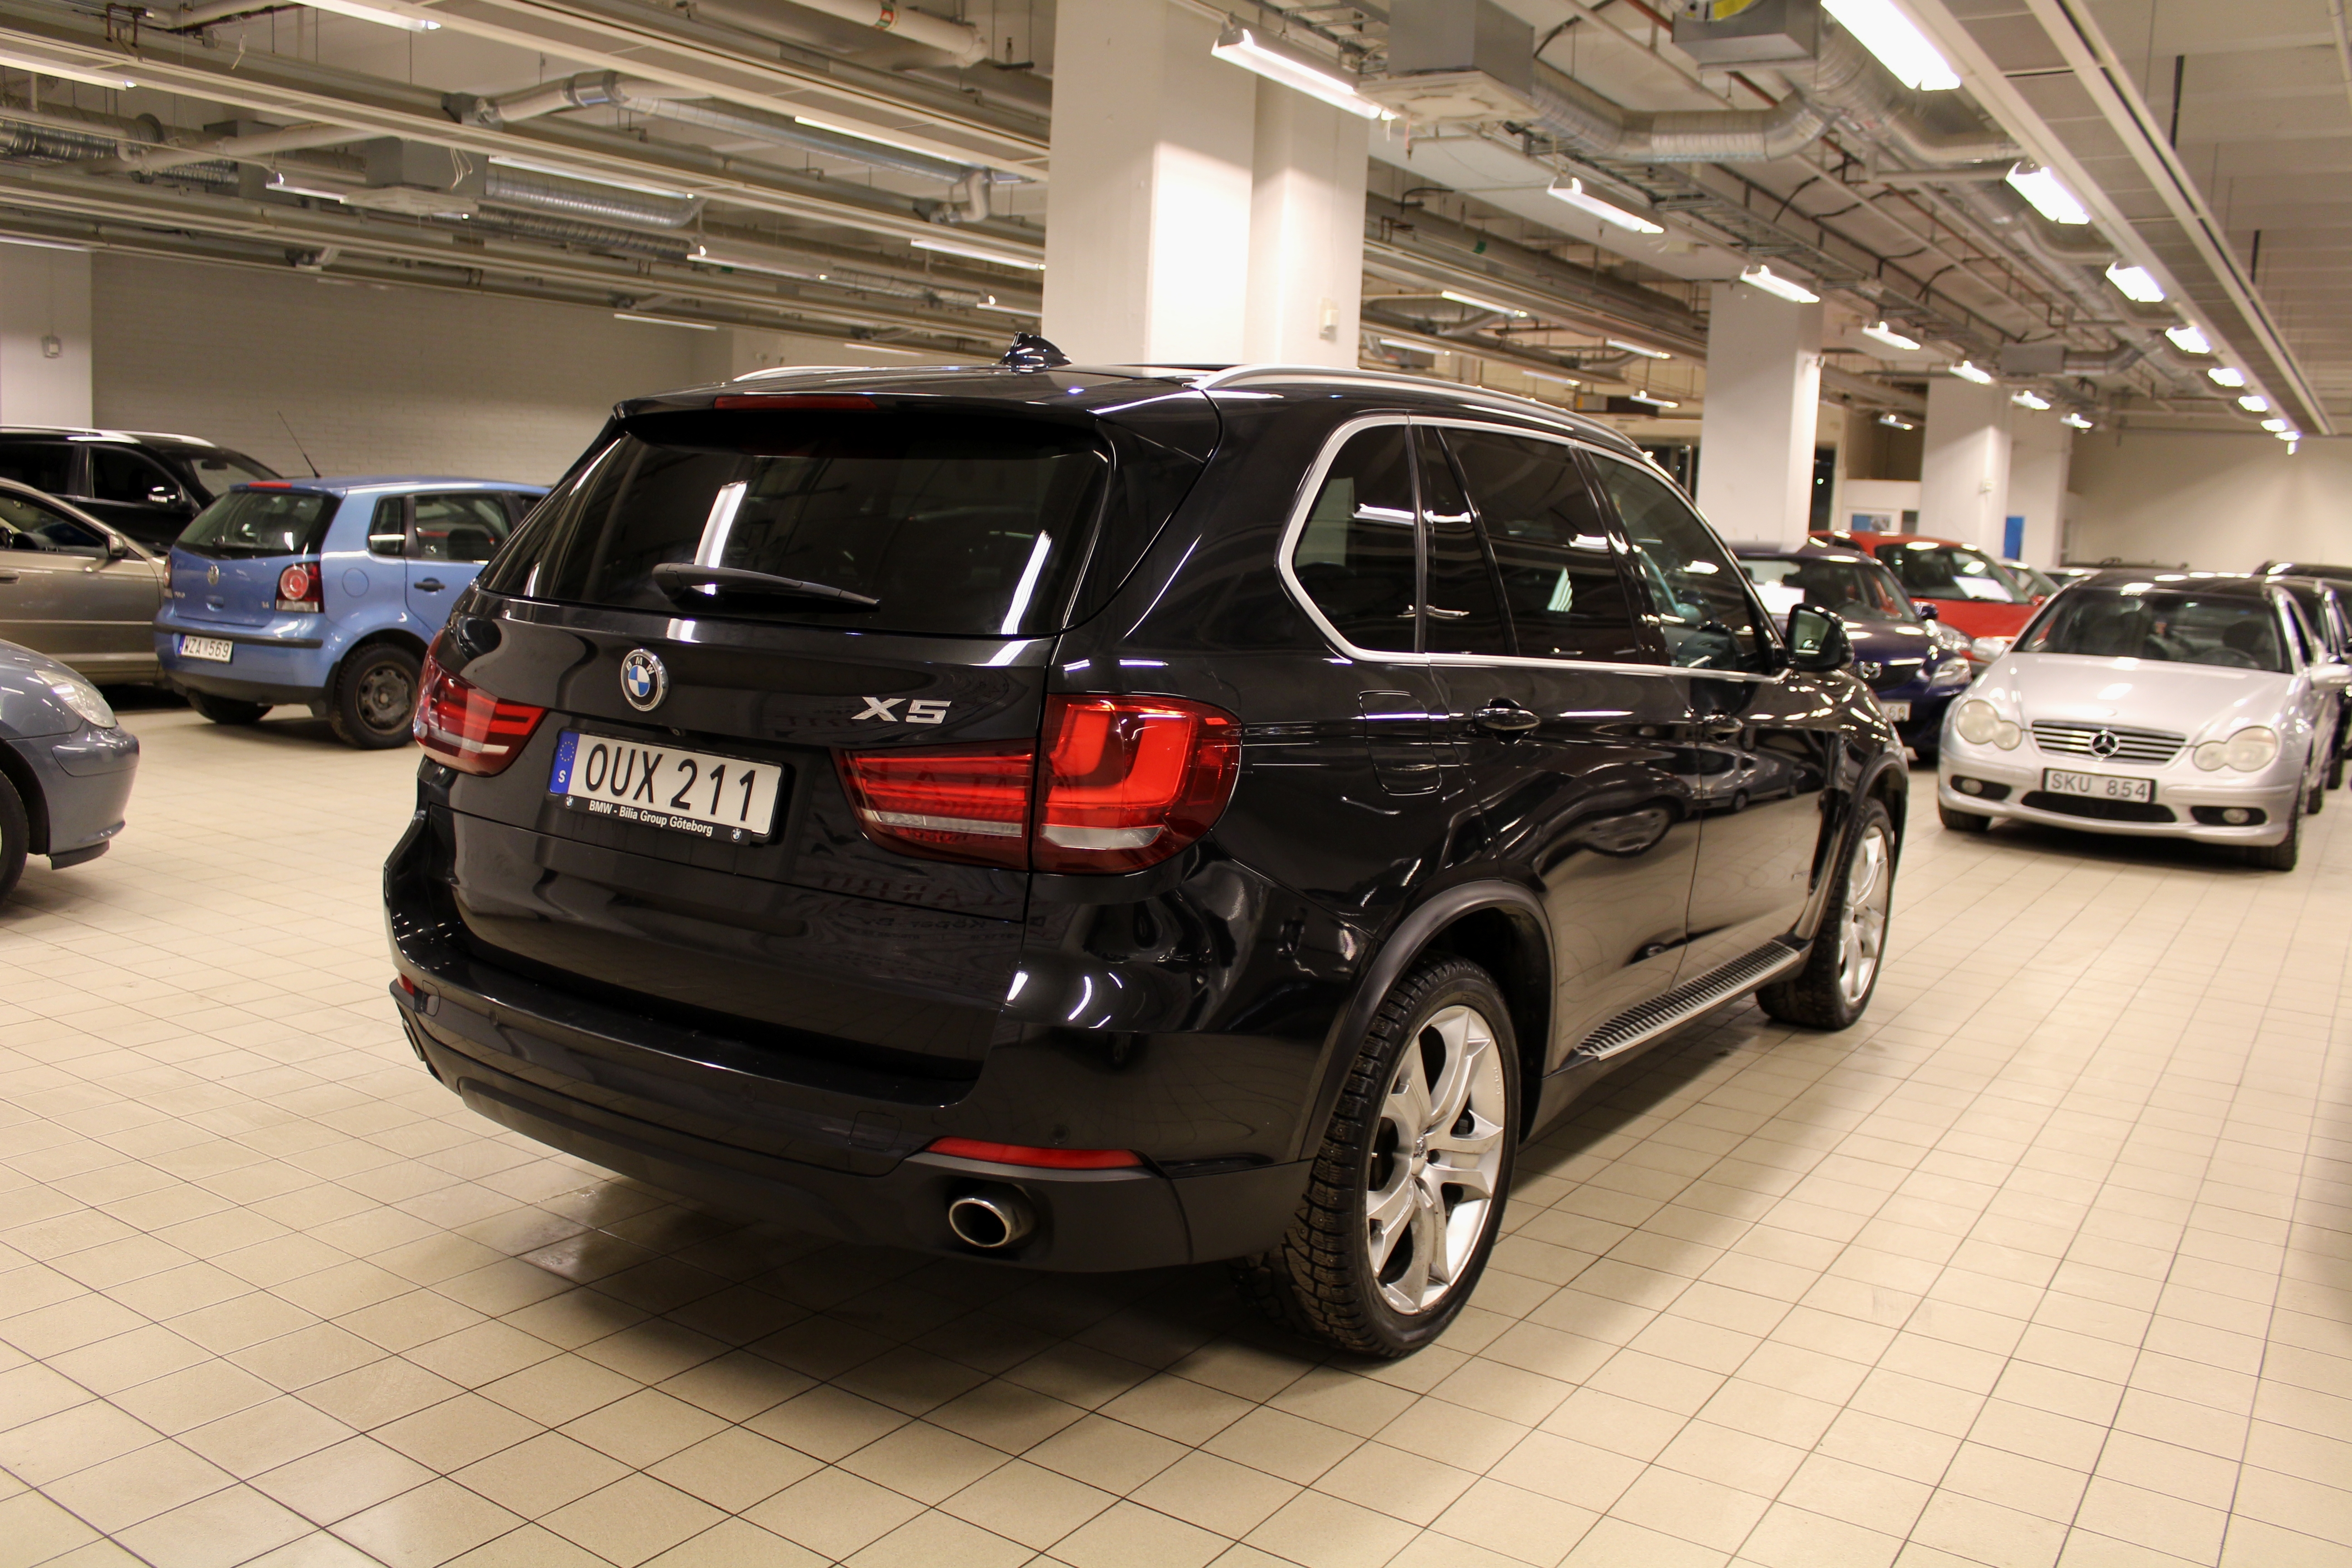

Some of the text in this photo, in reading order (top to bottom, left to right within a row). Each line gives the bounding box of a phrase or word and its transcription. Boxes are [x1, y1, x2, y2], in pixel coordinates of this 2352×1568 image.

[183, 637, 229, 657] WZA 569
[626, 656, 655, 675] BMW
[851, 696, 952, 724] X5
[558, 769, 566, 784] S
[585, 743, 756, 822] OUX 211
[2052, 773, 2146, 799] SKU 854
[588, 800, 612, 815] BMW
[619, 806, 638, 820] Bilia
[640, 810, 667, 828] Group
[669, 816, 713, 837] Göteborg
